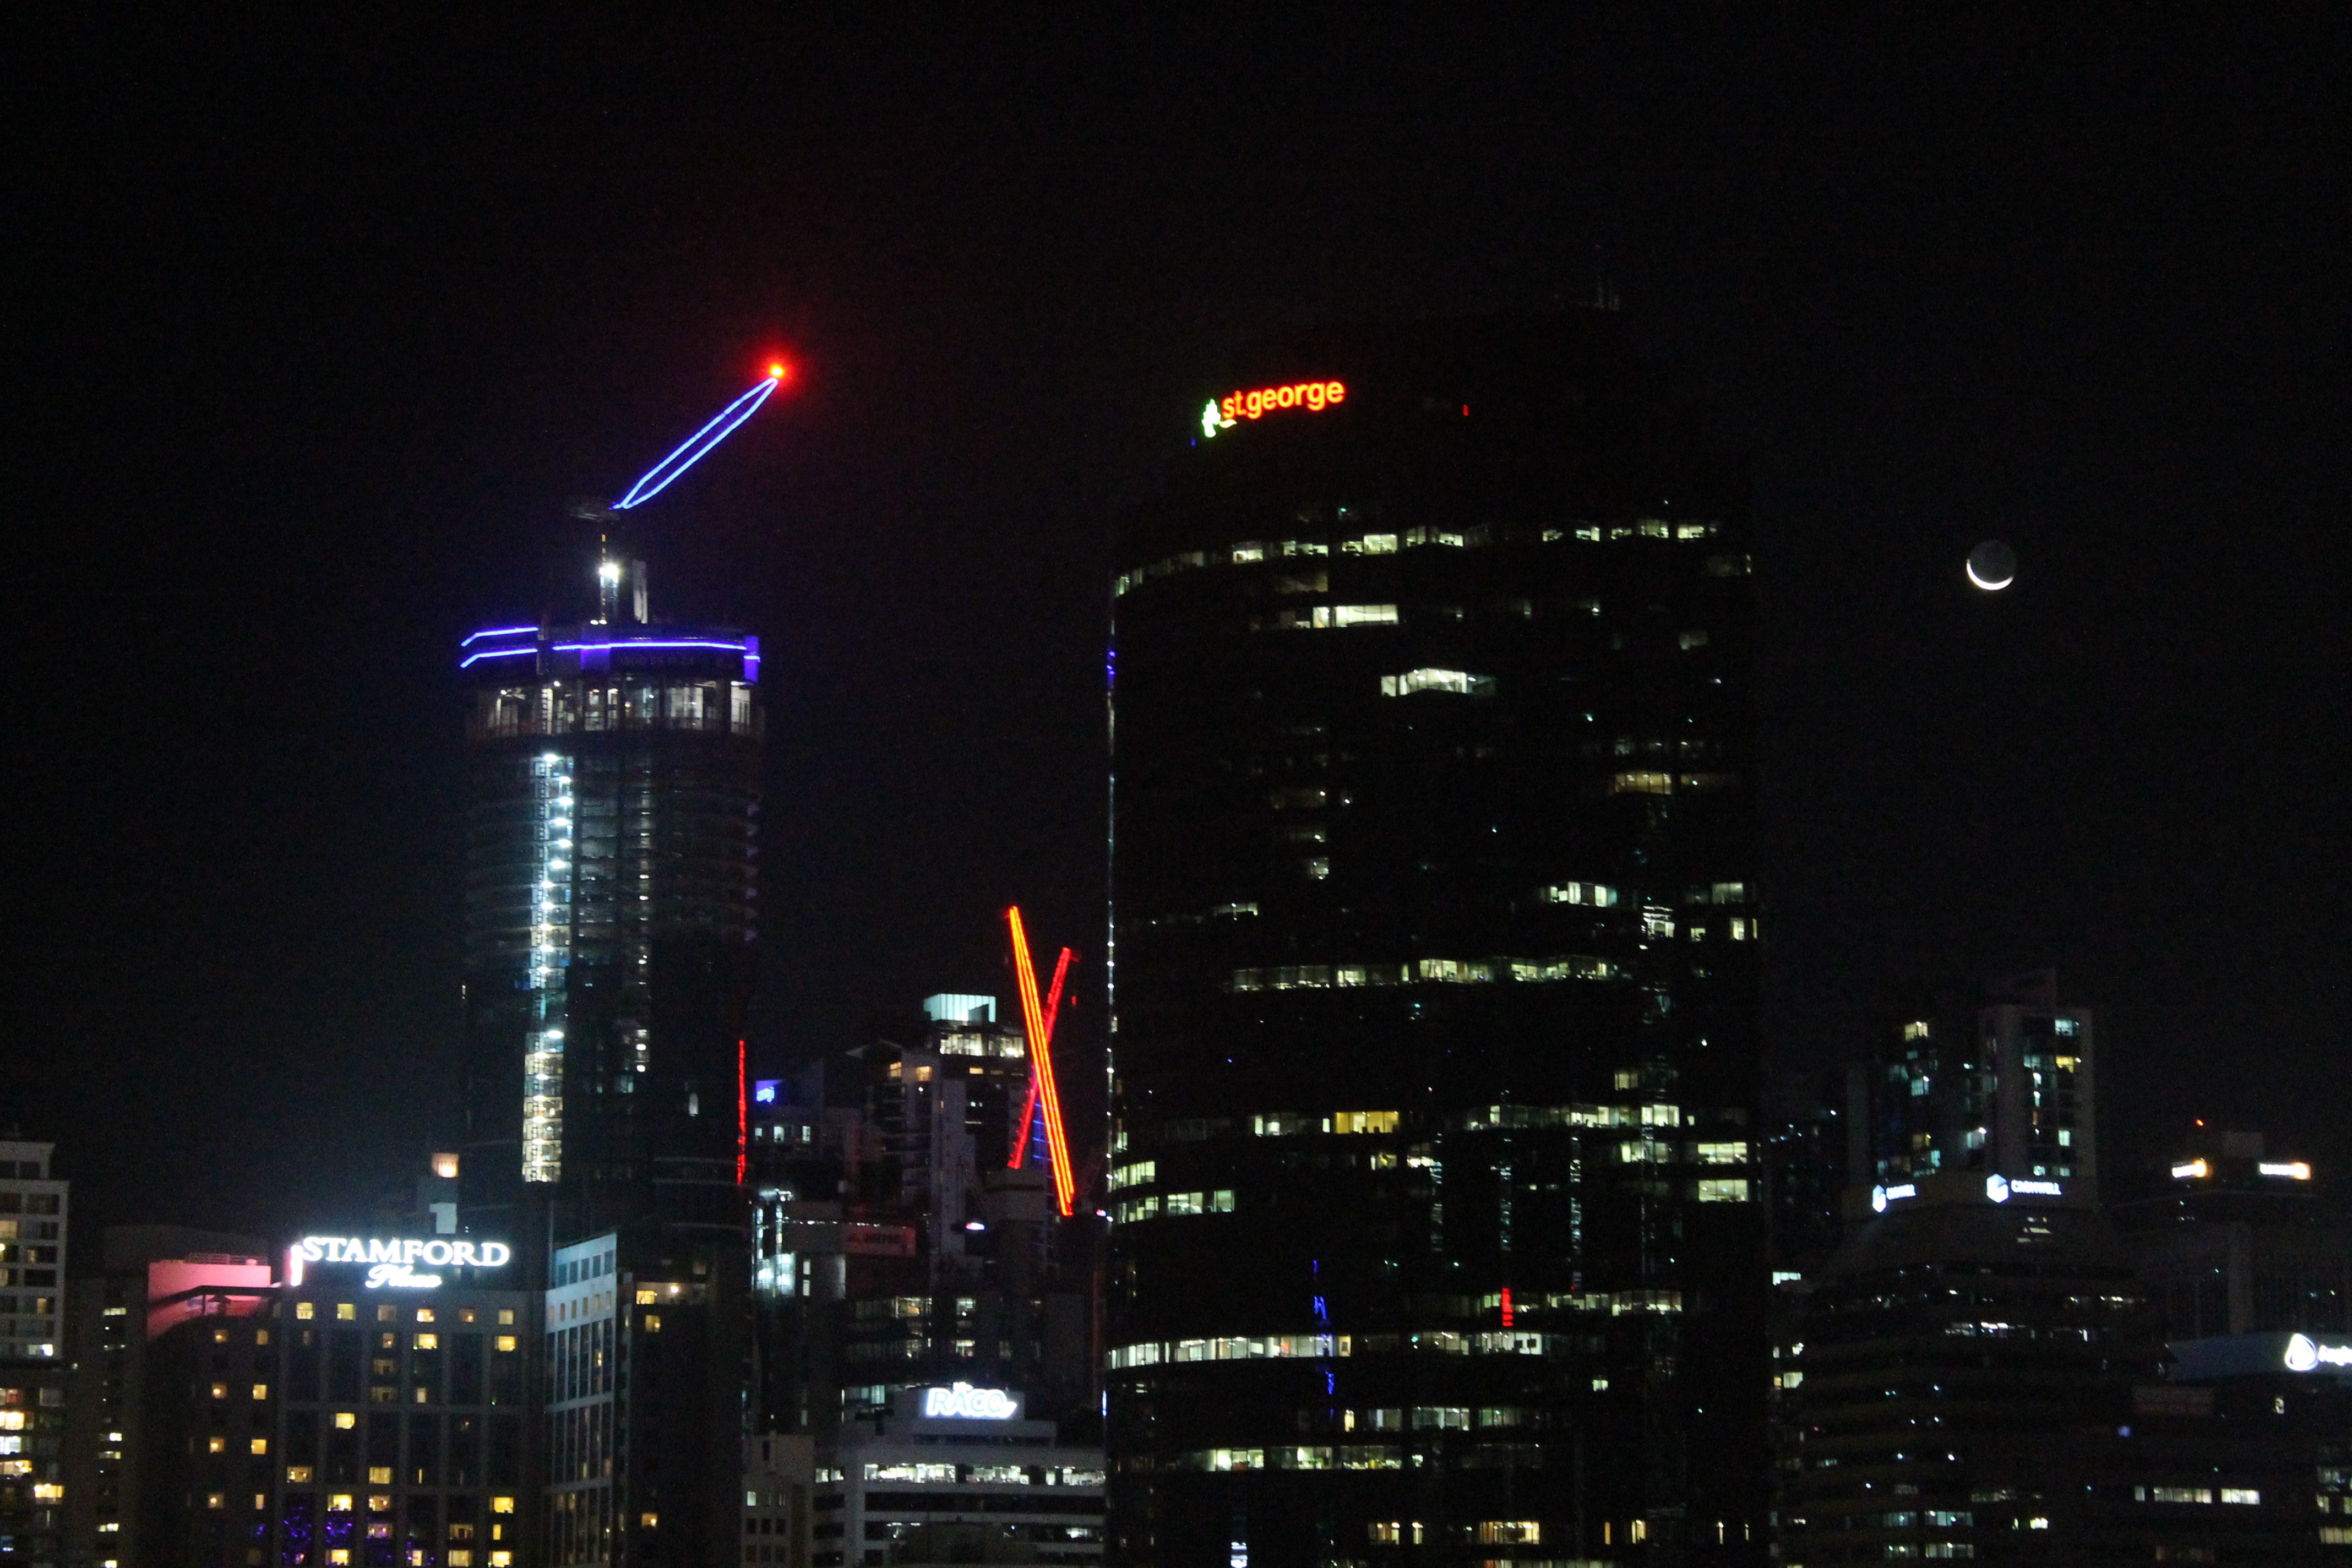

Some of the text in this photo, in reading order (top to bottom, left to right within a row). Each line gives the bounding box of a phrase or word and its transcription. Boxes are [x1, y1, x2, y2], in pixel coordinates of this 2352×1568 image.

[1222, 381, 1347, 420] st.george
[302, 1235, 510, 1267] STAMFORD
[926, 1386, 1014, 1418] RACQ
